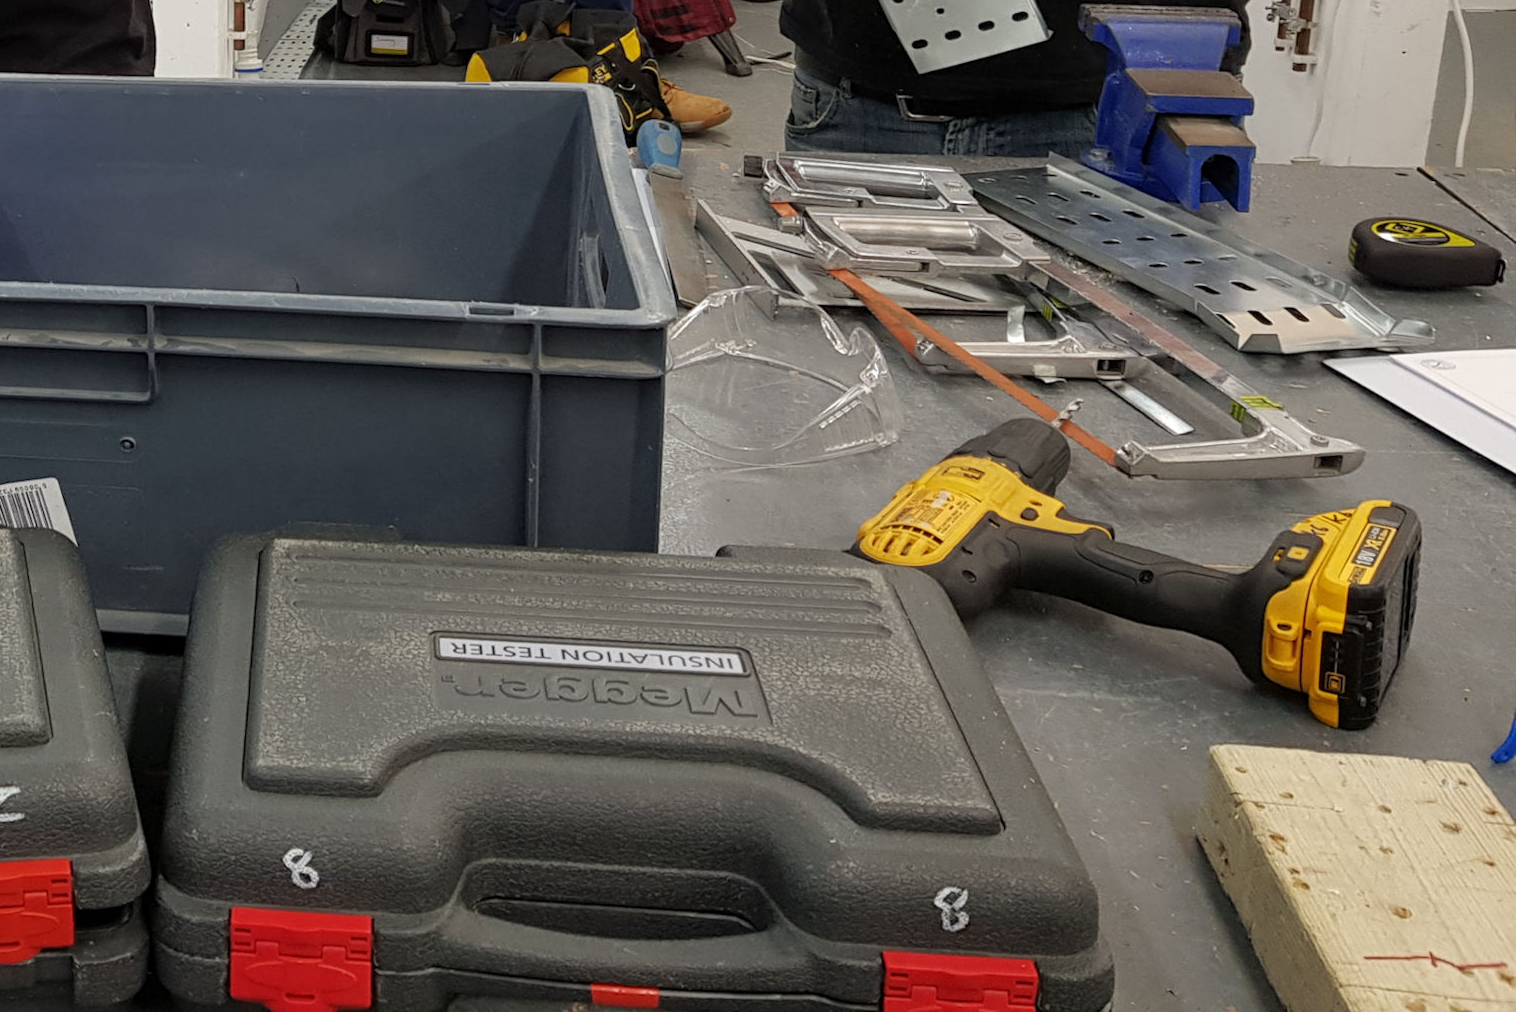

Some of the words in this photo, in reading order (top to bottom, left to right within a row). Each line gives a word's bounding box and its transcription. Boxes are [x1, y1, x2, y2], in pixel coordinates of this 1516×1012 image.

[1355, 549, 1376, 567] 18V
[451, 642, 552, 659] TESTER
[562, 648, 733, 669] INSULATION
[454, 676, 759, 718] Megger
[282, 848, 320, 889] 8
[934, 886, 970, 932] 8
